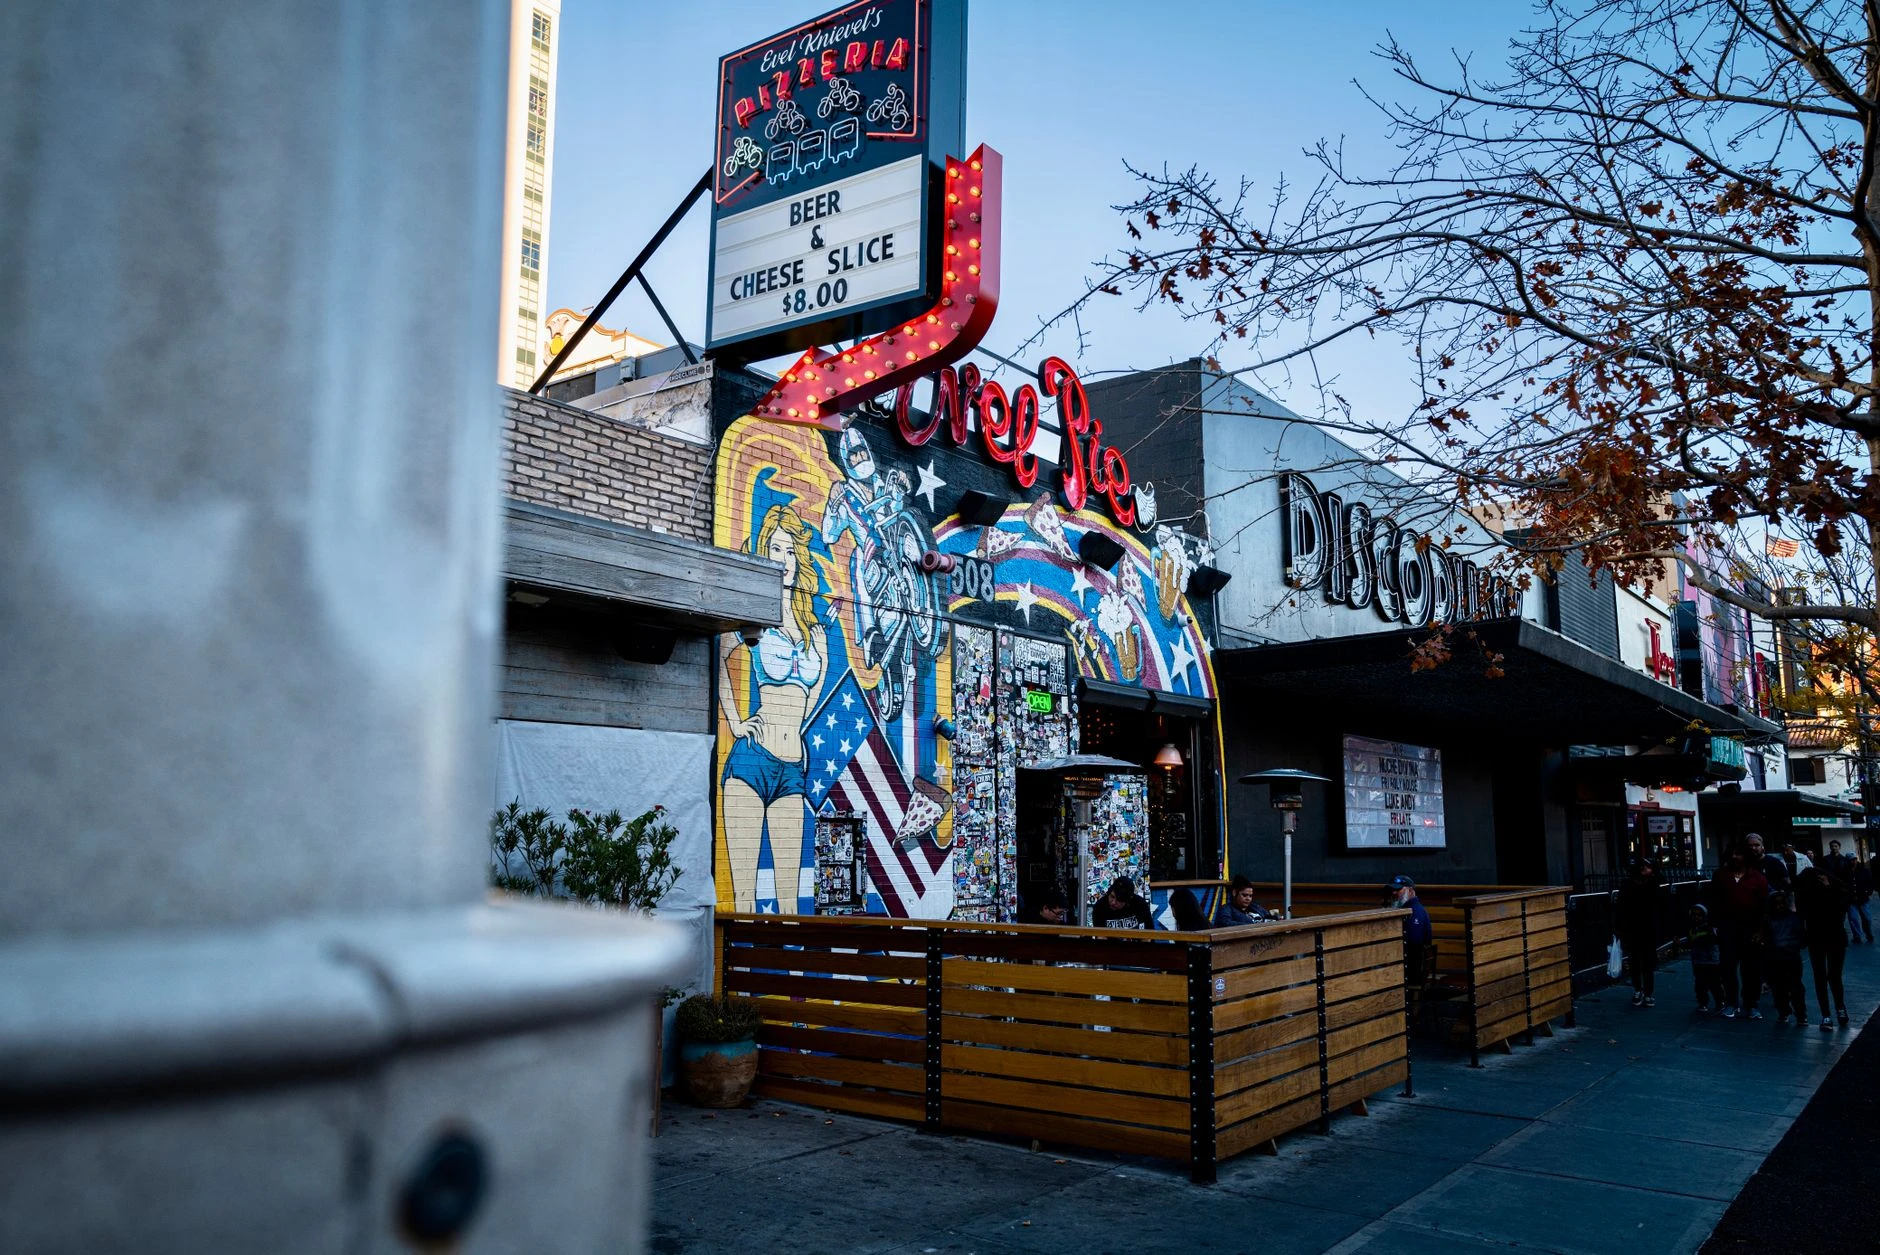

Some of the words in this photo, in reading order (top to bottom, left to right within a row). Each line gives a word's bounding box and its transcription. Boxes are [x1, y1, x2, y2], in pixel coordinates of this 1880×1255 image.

[760, 40, 796, 73] Evel
[799, 7, 883, 56] Knievel's
[734, 37, 911, 129] PIZZERIA
[789, 189, 841, 227] BEER
[810, 224, 825, 251] &
[730, 259, 804, 301] CHEESE
[827, 233, 894, 275] SLICE
[782, 278, 848, 315] $8.00
[1038, 356, 1135, 528] Pie
[951, 556, 995, 602] 508
[1028, 694, 1050, 710] OPEN
[1388, 829, 1415, 844] GHASTLY
